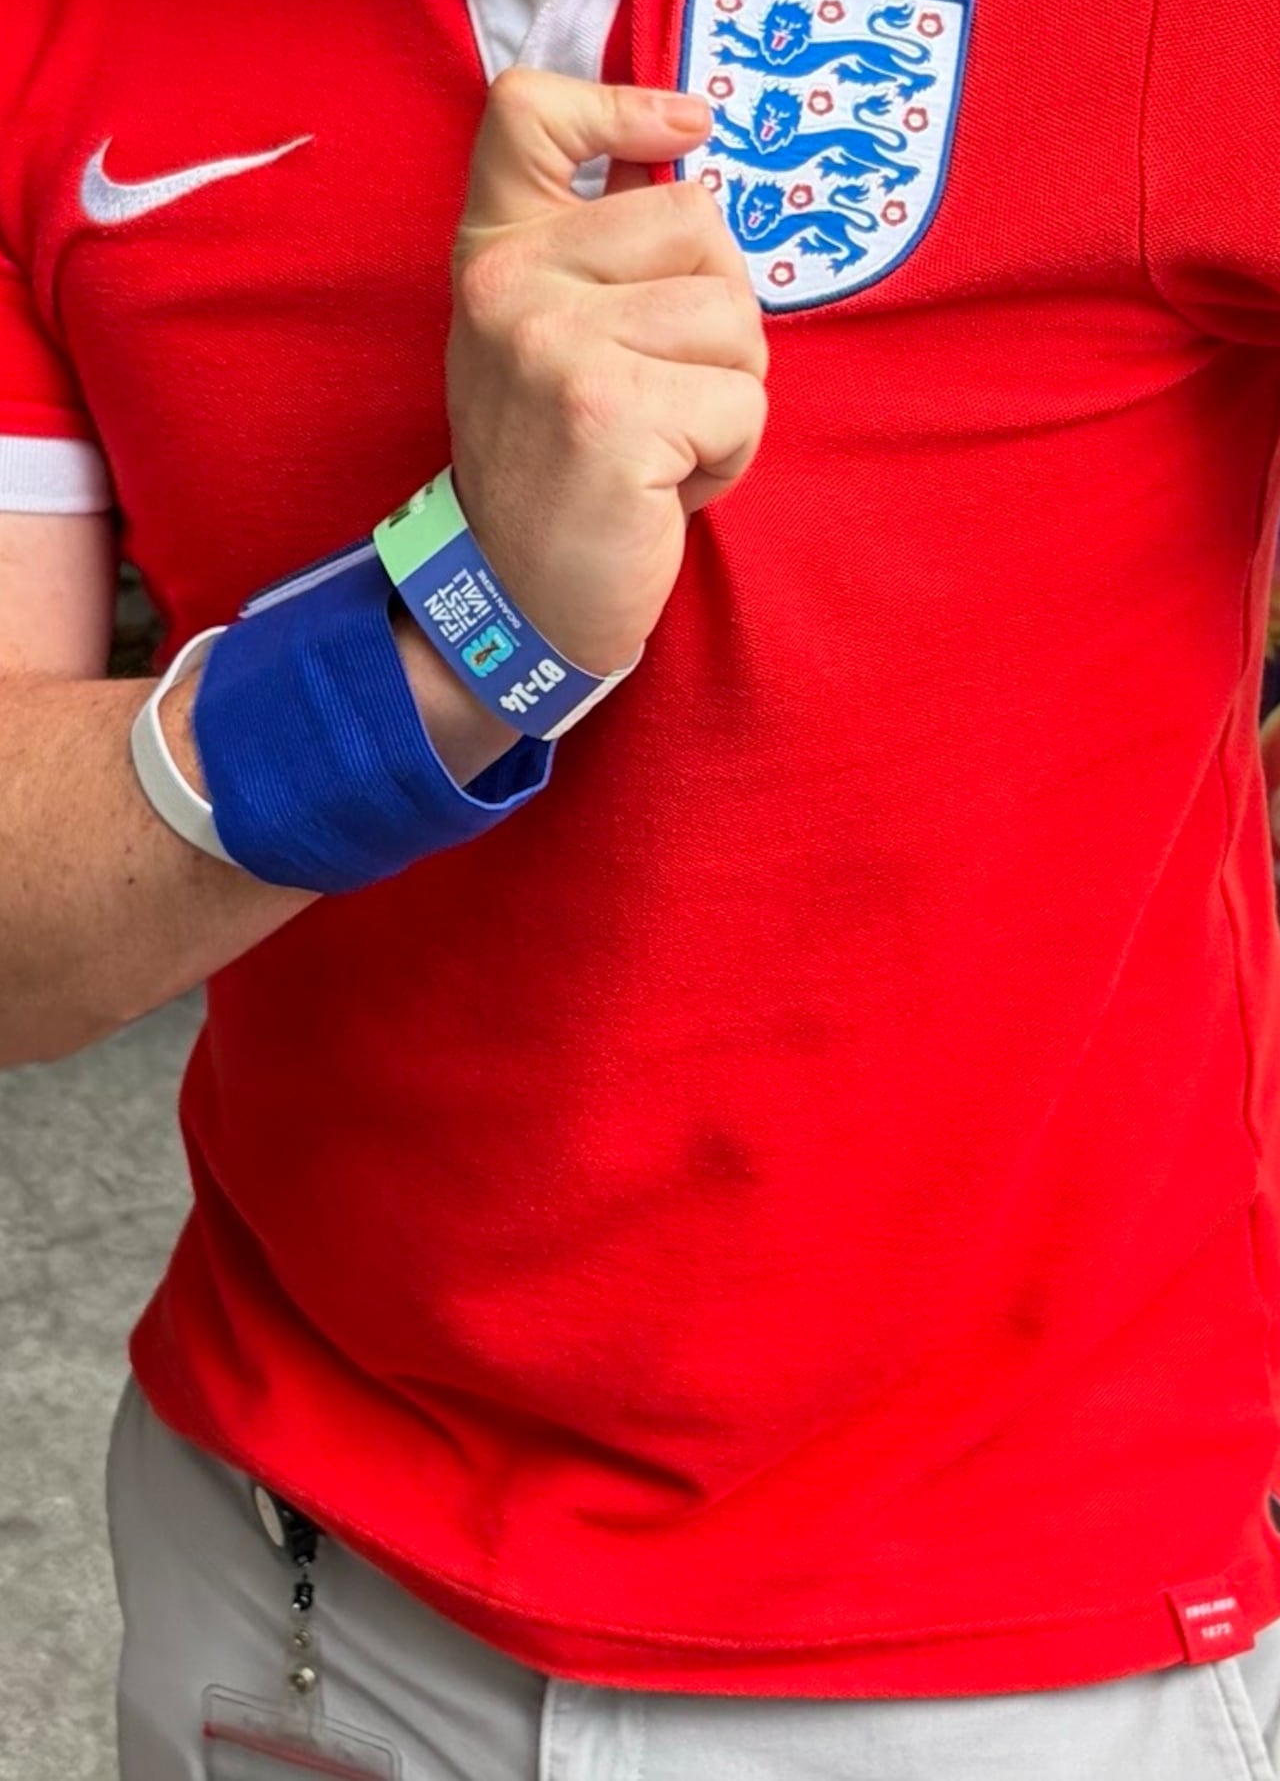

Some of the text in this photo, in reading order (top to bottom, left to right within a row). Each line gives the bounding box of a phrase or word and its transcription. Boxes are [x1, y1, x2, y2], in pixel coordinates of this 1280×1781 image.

[422, 593, 458, 637] FAN
[437, 582, 478, 632] FEST
[499, 658, 567, 714] 07-14
